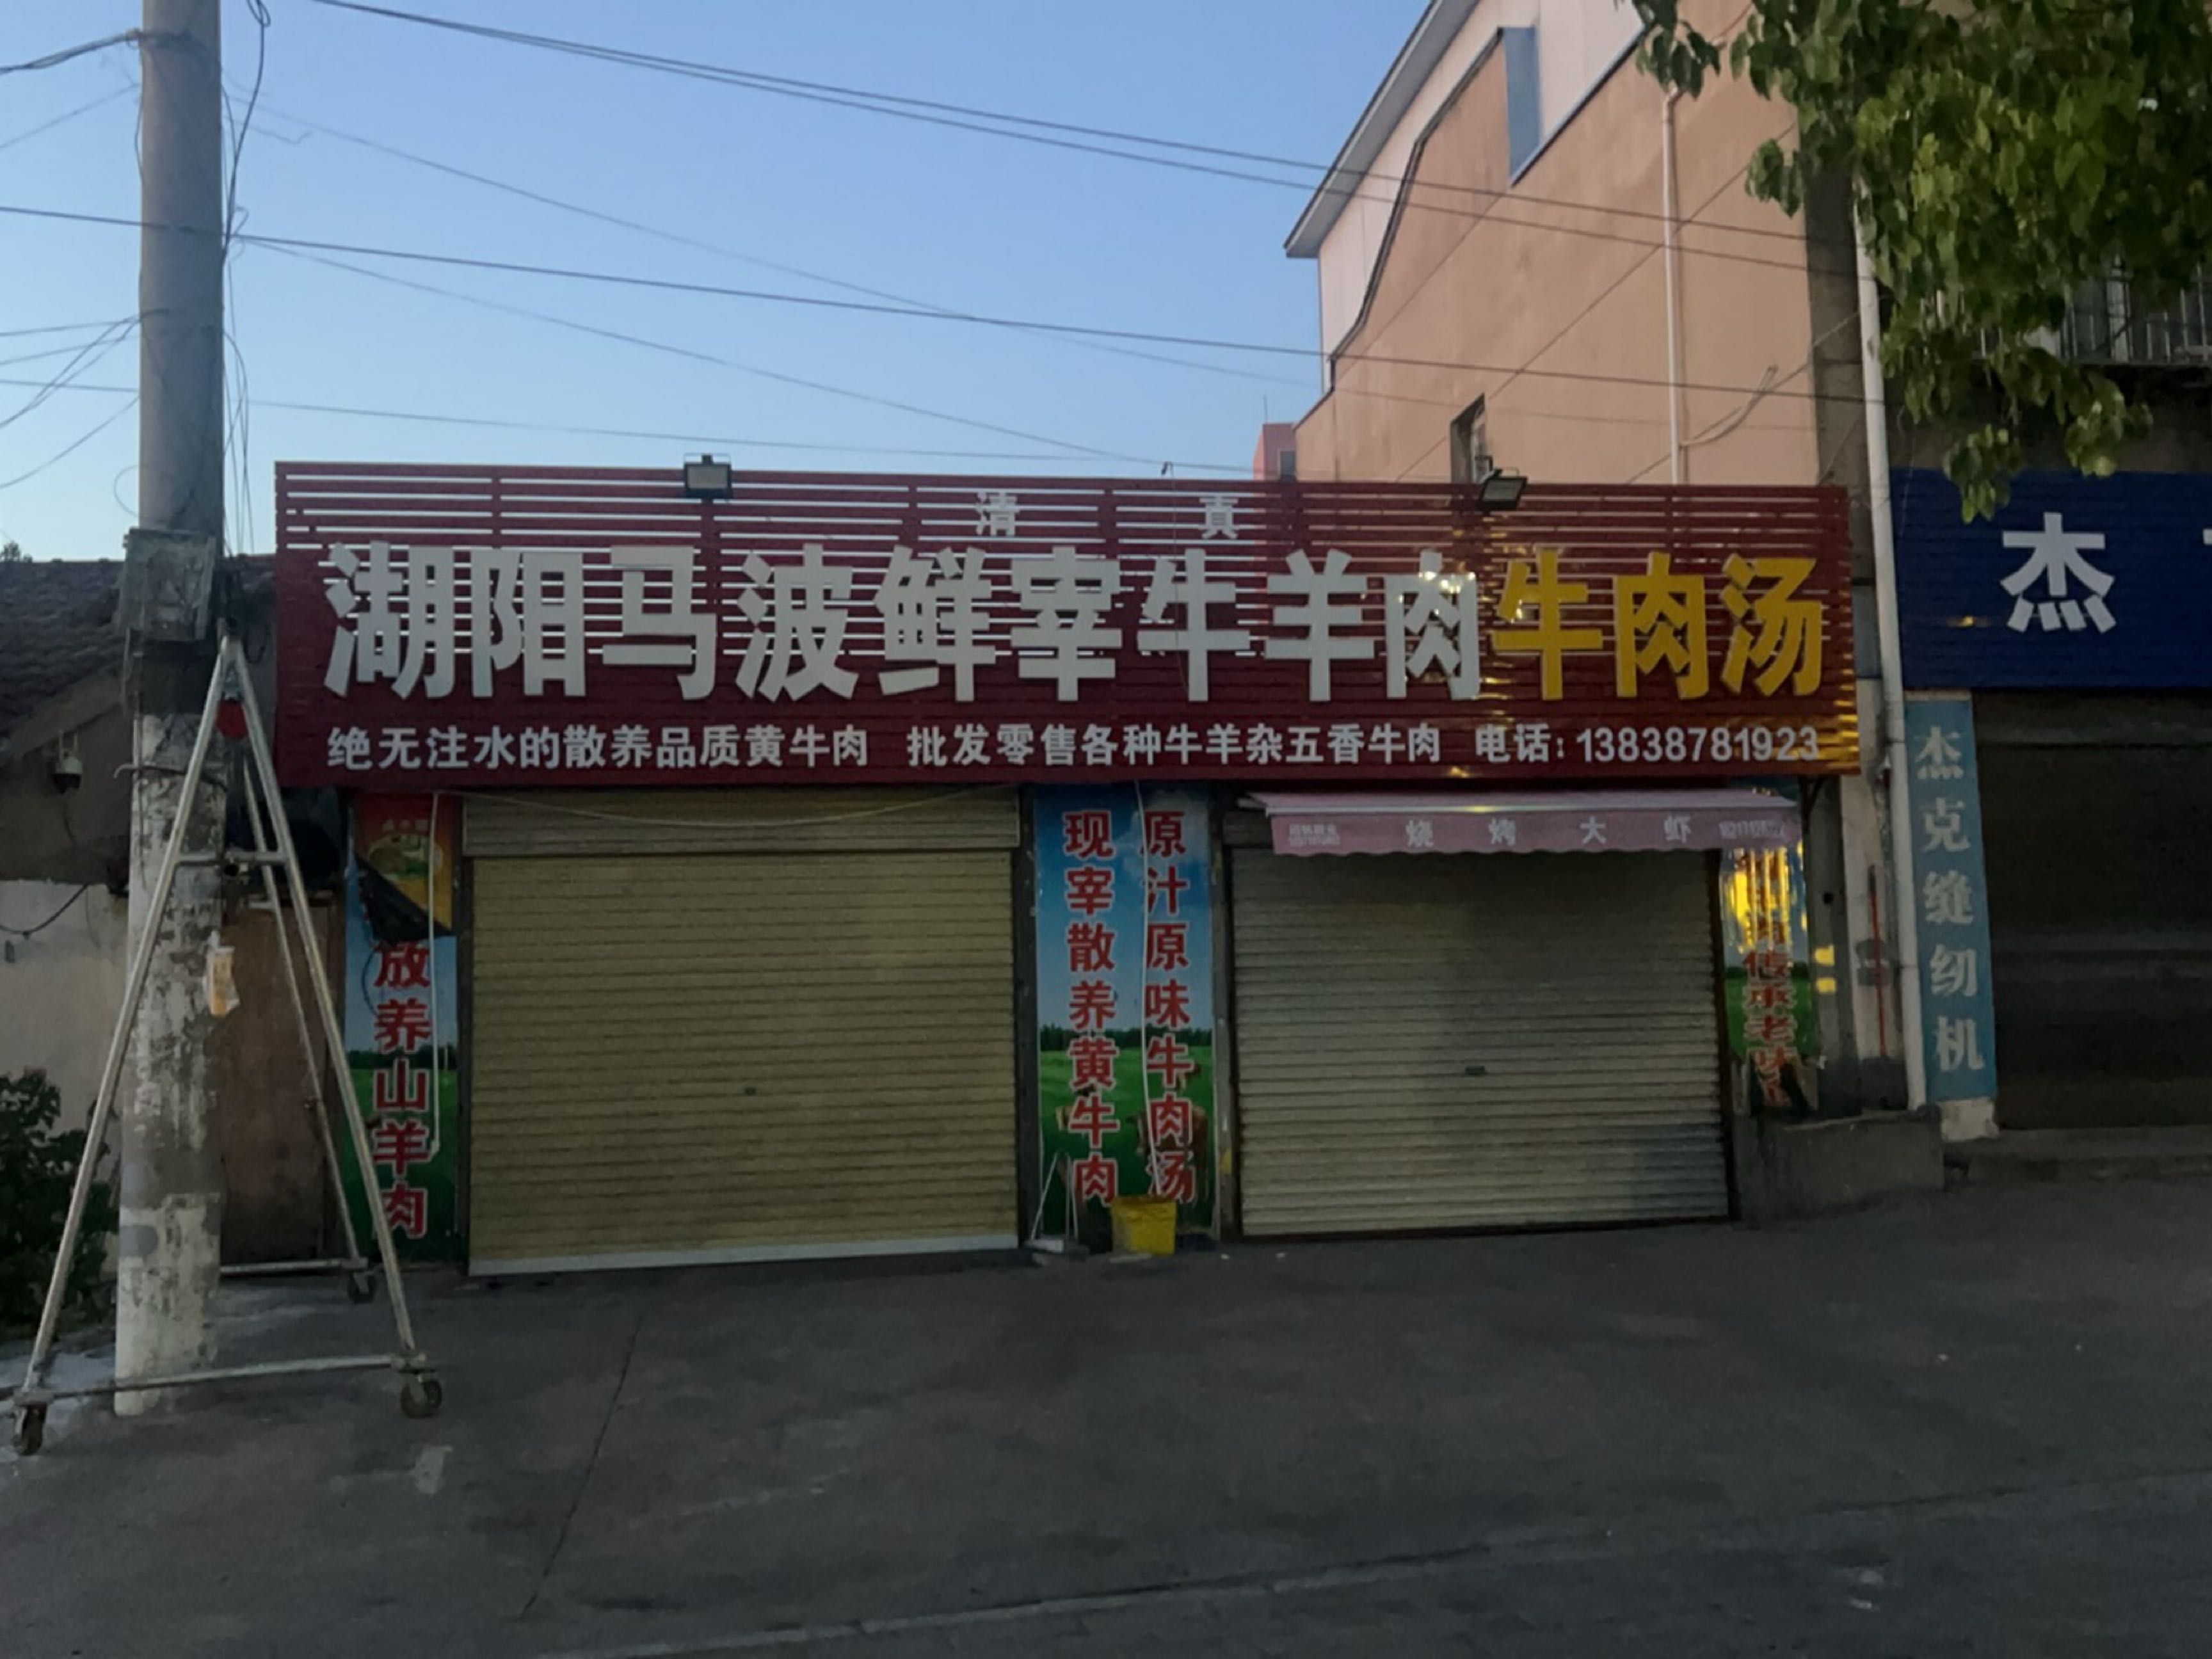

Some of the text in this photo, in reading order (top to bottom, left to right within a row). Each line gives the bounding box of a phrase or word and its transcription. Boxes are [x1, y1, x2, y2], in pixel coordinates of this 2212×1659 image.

[975, 491, 1239, 539] 清真
[328, 725, 868, 769] 绝无注水的散养品质黄牛肉
[907, 723, 1440, 765] 批发零售各种牛羊杂五香牛肉
[1915, 726, 1984, 1071] 杰克缝纫机
[1063, 810, 1119, 1203] 现宰散养黄牛肉
[1141, 810, 1196, 1203] 原汁原味牛肉汤
